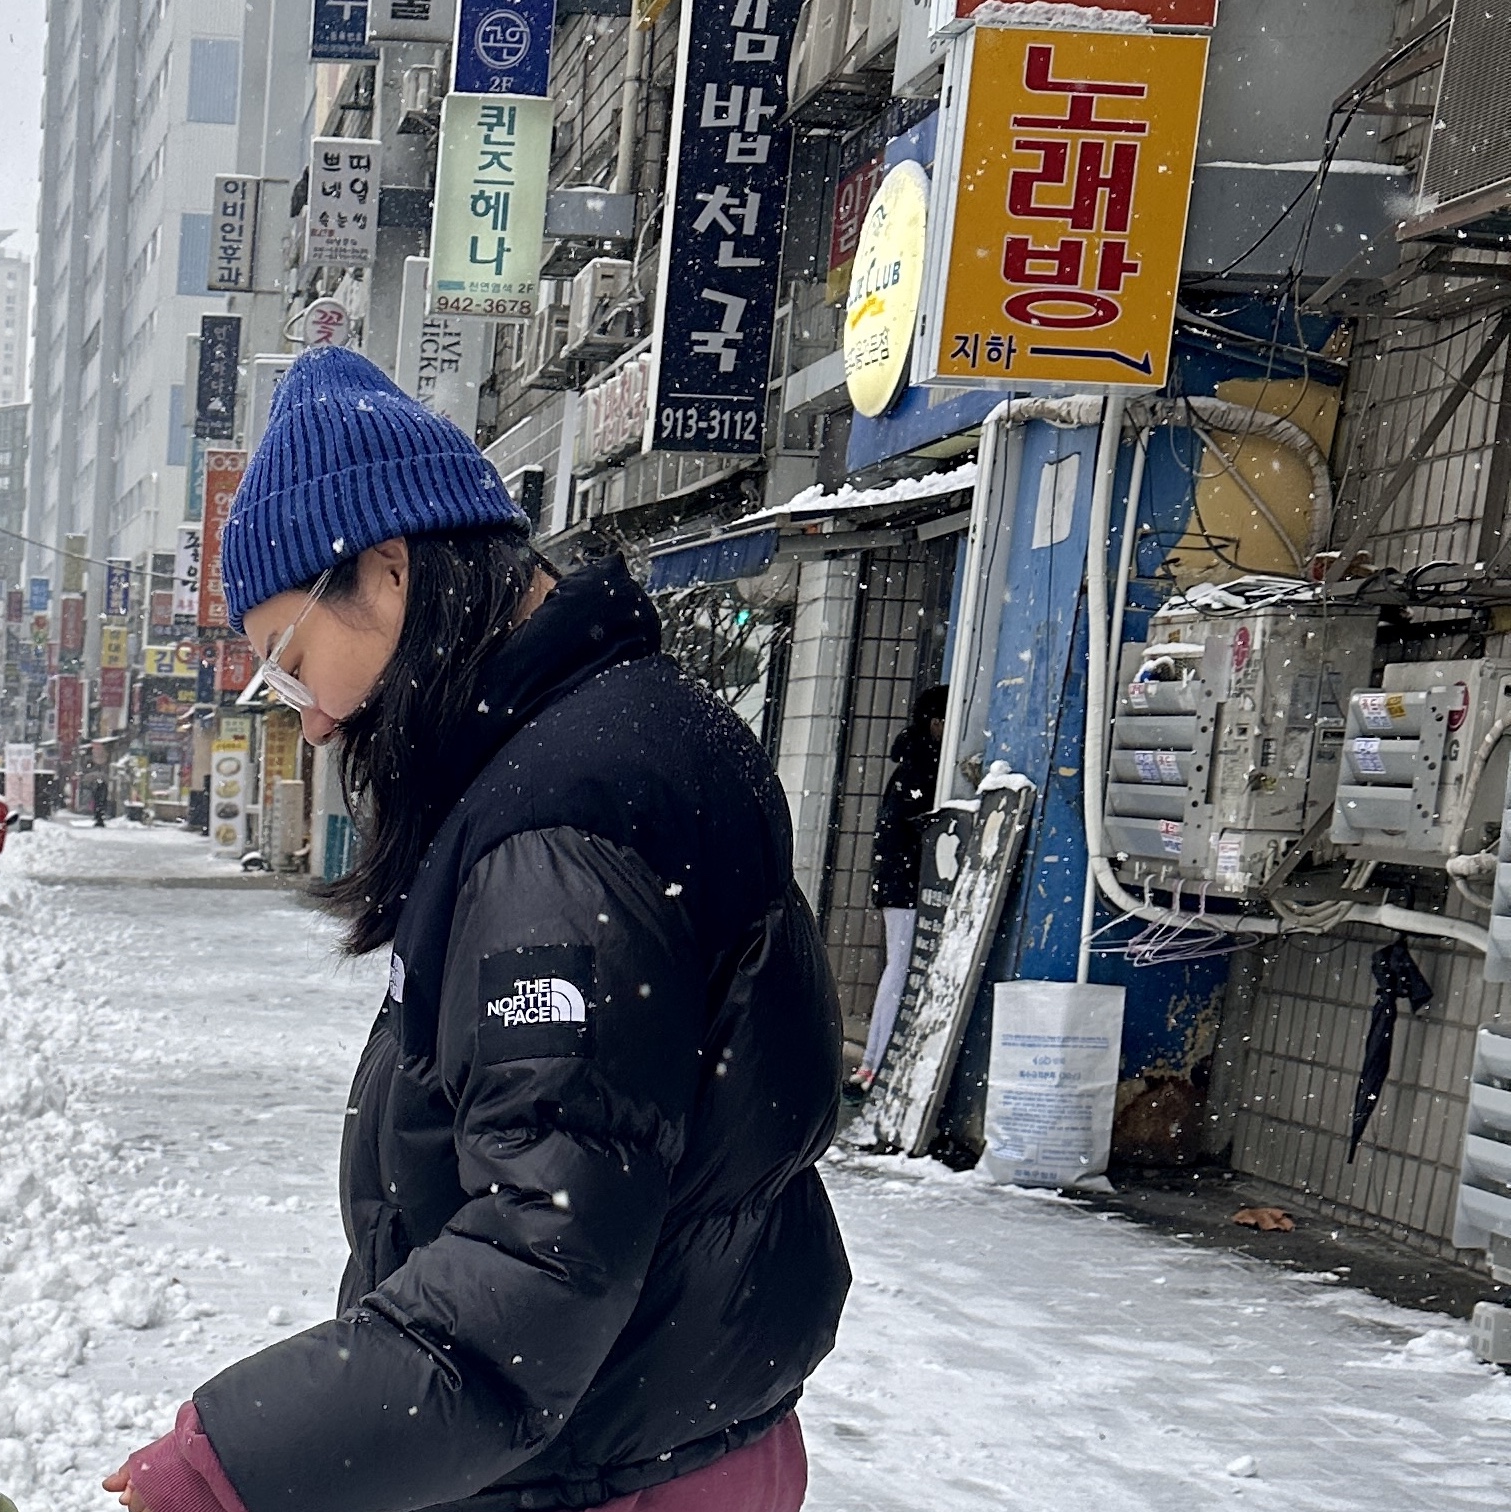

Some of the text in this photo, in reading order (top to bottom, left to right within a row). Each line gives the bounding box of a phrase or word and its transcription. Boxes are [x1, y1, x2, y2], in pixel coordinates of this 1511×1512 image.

[489, 76, 514, 93] 2F
[469, 104, 517, 276] 퀸즈헤나
[1001, 44, 1149, 330] 노래방
[217, 180, 247, 286] 이비인후과
[518, 283, 535, 294] 2F
[437, 296, 532, 316] 942-3678
[312, 308, 344, 345] 꽃
[950, 332, 1018, 370] 지하
[661, 407, 757, 440] 913-3112
[514, 978, 551, 994] THE
[487, 992, 551, 1017] NORTH
[503, 1006, 551, 1027] FACE
